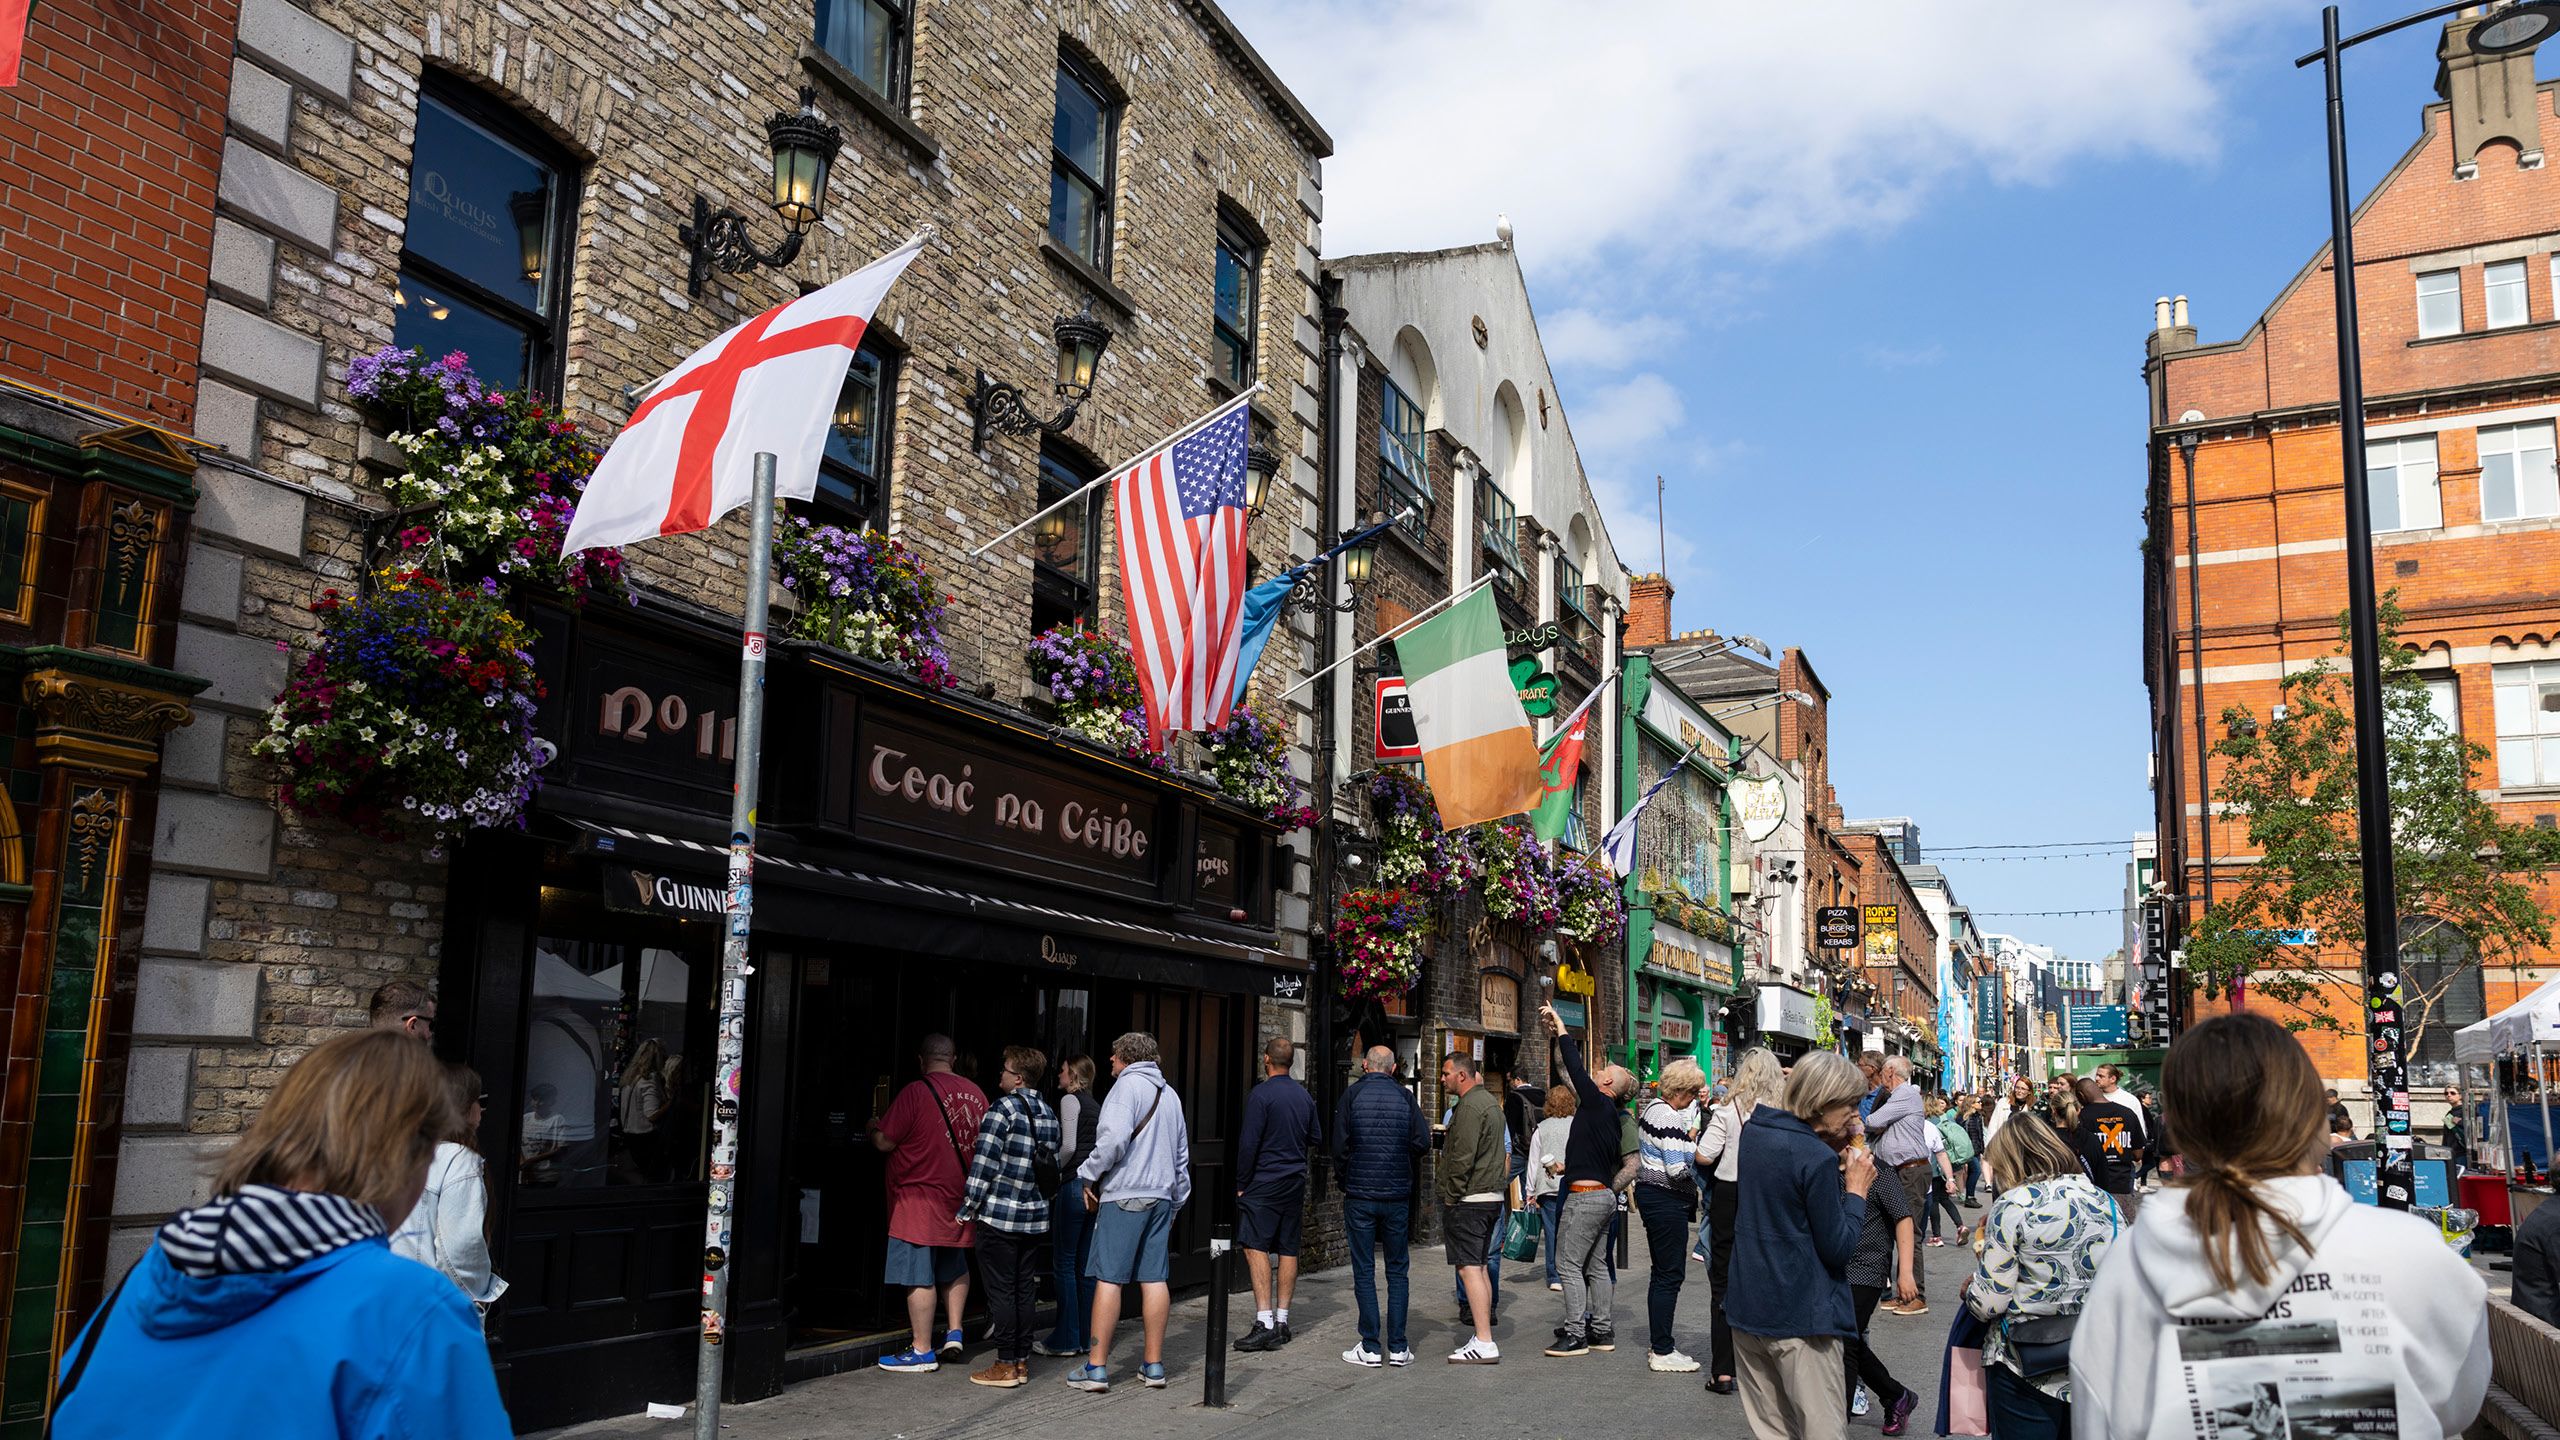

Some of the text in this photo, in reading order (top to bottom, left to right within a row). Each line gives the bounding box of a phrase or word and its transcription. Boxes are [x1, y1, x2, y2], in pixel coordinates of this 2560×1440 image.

[424, 171, 497, 229] Quays
[1504, 624, 1558, 648] uays
[995, 793, 1044, 834] na
[1865, 906, 1897, 917] RORY'S
[1042, 934, 1078, 970] Quays
[1823, 938, 1853, 946] KEBABS
[2377, 1407, 2396, 1417] FEEL
